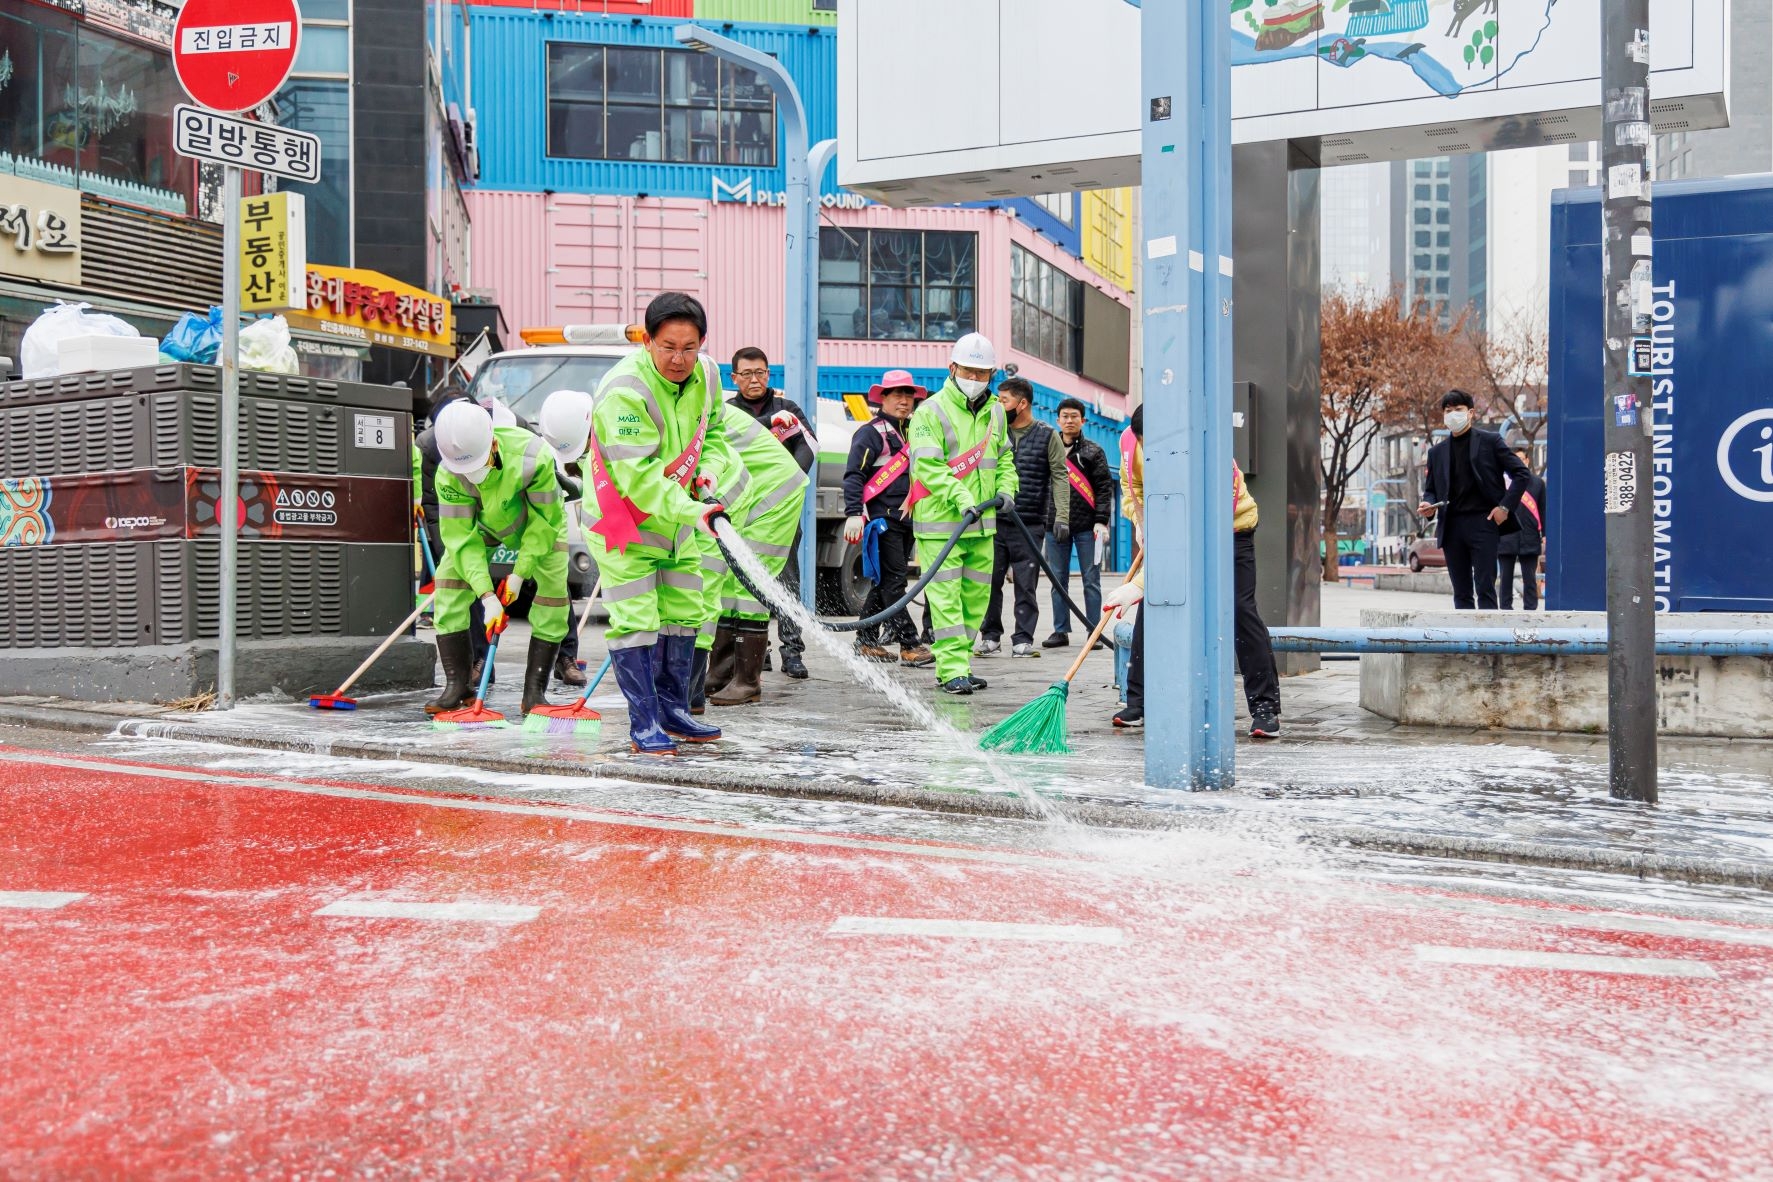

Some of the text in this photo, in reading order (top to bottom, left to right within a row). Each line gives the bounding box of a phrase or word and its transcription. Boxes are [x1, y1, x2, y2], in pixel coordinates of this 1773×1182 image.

[193, 25, 280, 50] 진입금지
[185, 116, 310, 173] 일방통행
[757, 190, 865, 210] PLAOUND
[244, 201, 275, 303] 부동산
[1651, 280, 1675, 414] TOURIST
[376, 429, 383, 445] 8
[618, 428, 640, 436] 마포구
